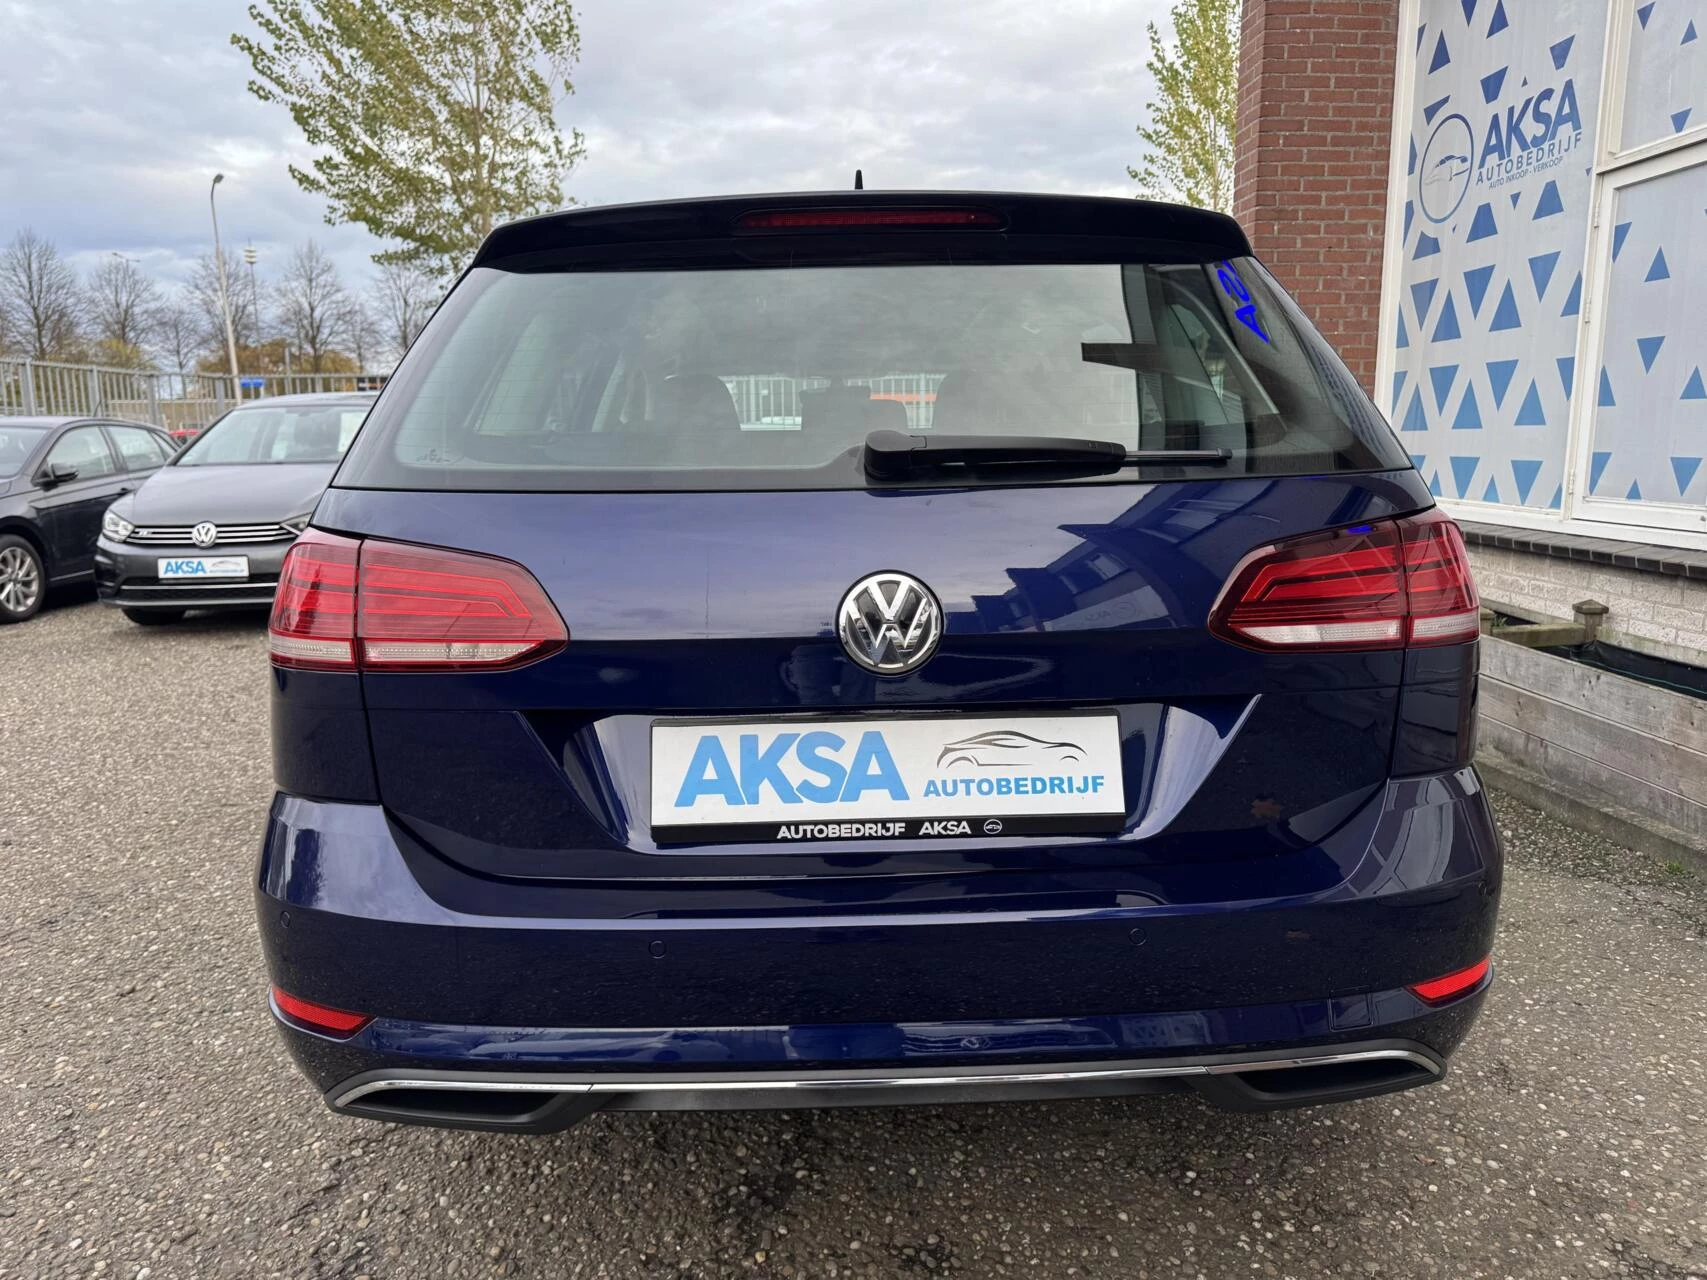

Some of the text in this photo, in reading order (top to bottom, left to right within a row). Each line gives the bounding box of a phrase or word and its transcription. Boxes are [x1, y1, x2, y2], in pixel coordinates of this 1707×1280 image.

[1478, 78, 1582, 170] AKSA
[1476, 132, 1582, 185] AUTOBEDRIJF
[1489, 179, 1504, 190] AUTO
[1506, 169, 1529, 183] INKOOP
[1533, 156, 1563, 175] VERKOOP
[163, 560, 207, 575] AKSA
[674, 731, 910, 807] AKSA
[923, 775, 1105, 798] AUTOBEDRIJF
[777, 820, 972, 840] AUTOBEDRIJF AKSA
